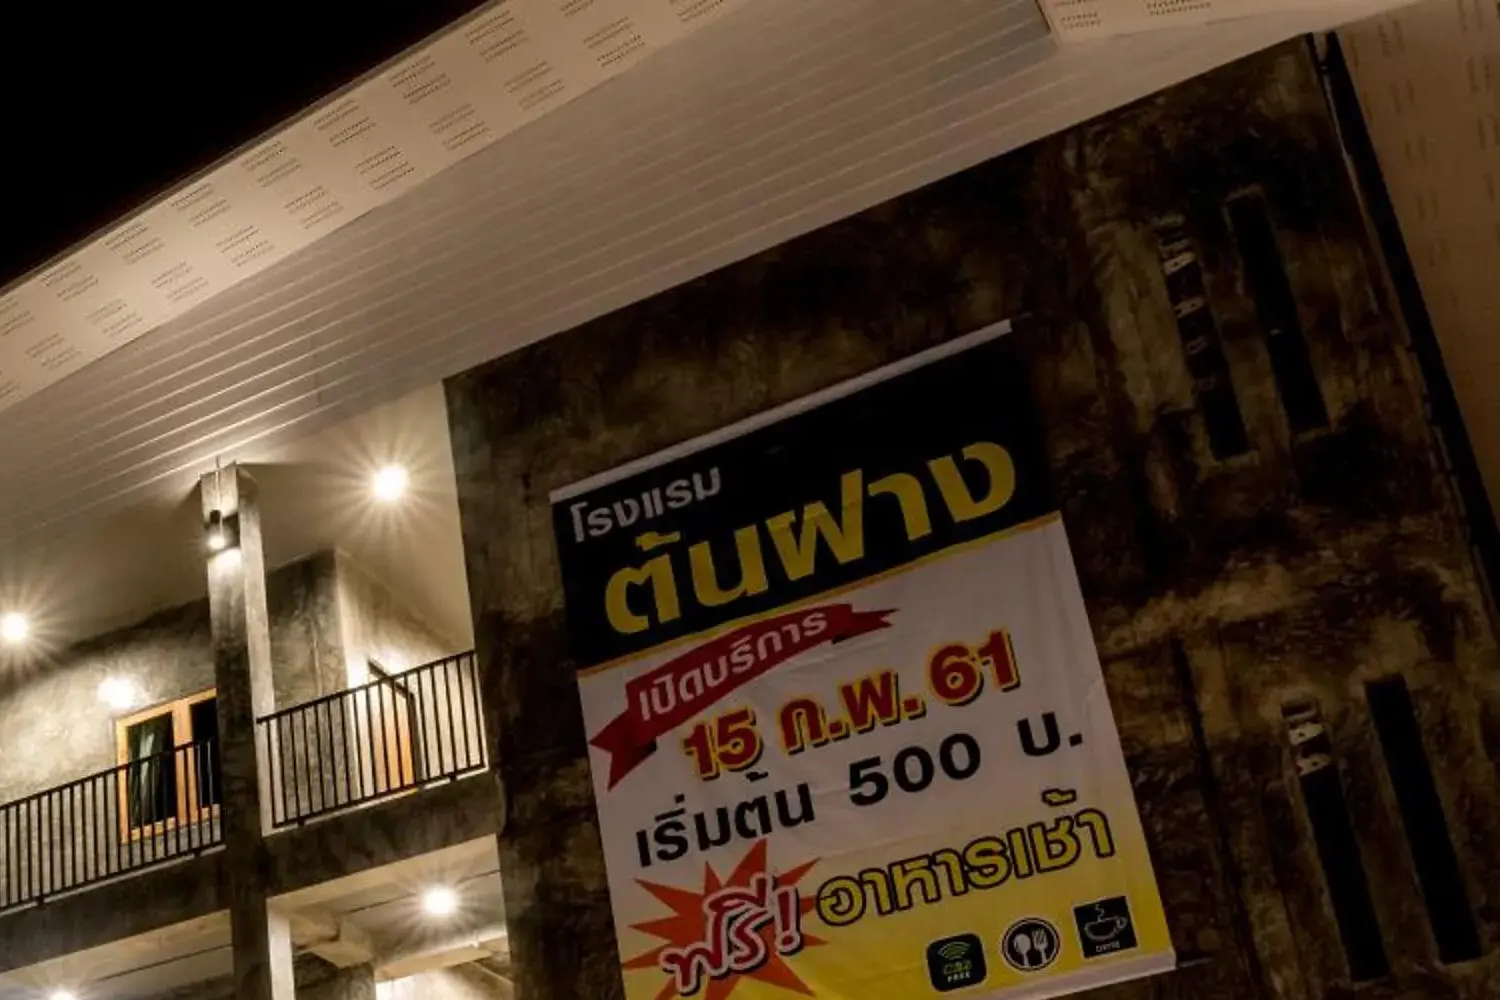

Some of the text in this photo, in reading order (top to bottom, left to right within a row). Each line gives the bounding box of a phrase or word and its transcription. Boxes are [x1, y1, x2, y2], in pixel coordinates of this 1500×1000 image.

[570, 465, 723, 544] โรงแรม
[637, 610, 828, 724] เปิดบริการ
[681, 628, 1020, 783] 15 ก.พ. 61
[636, 710, 1083, 868] เริ่มต้น 500 บ.
[815, 787, 1116, 927] อาหารเช้า
